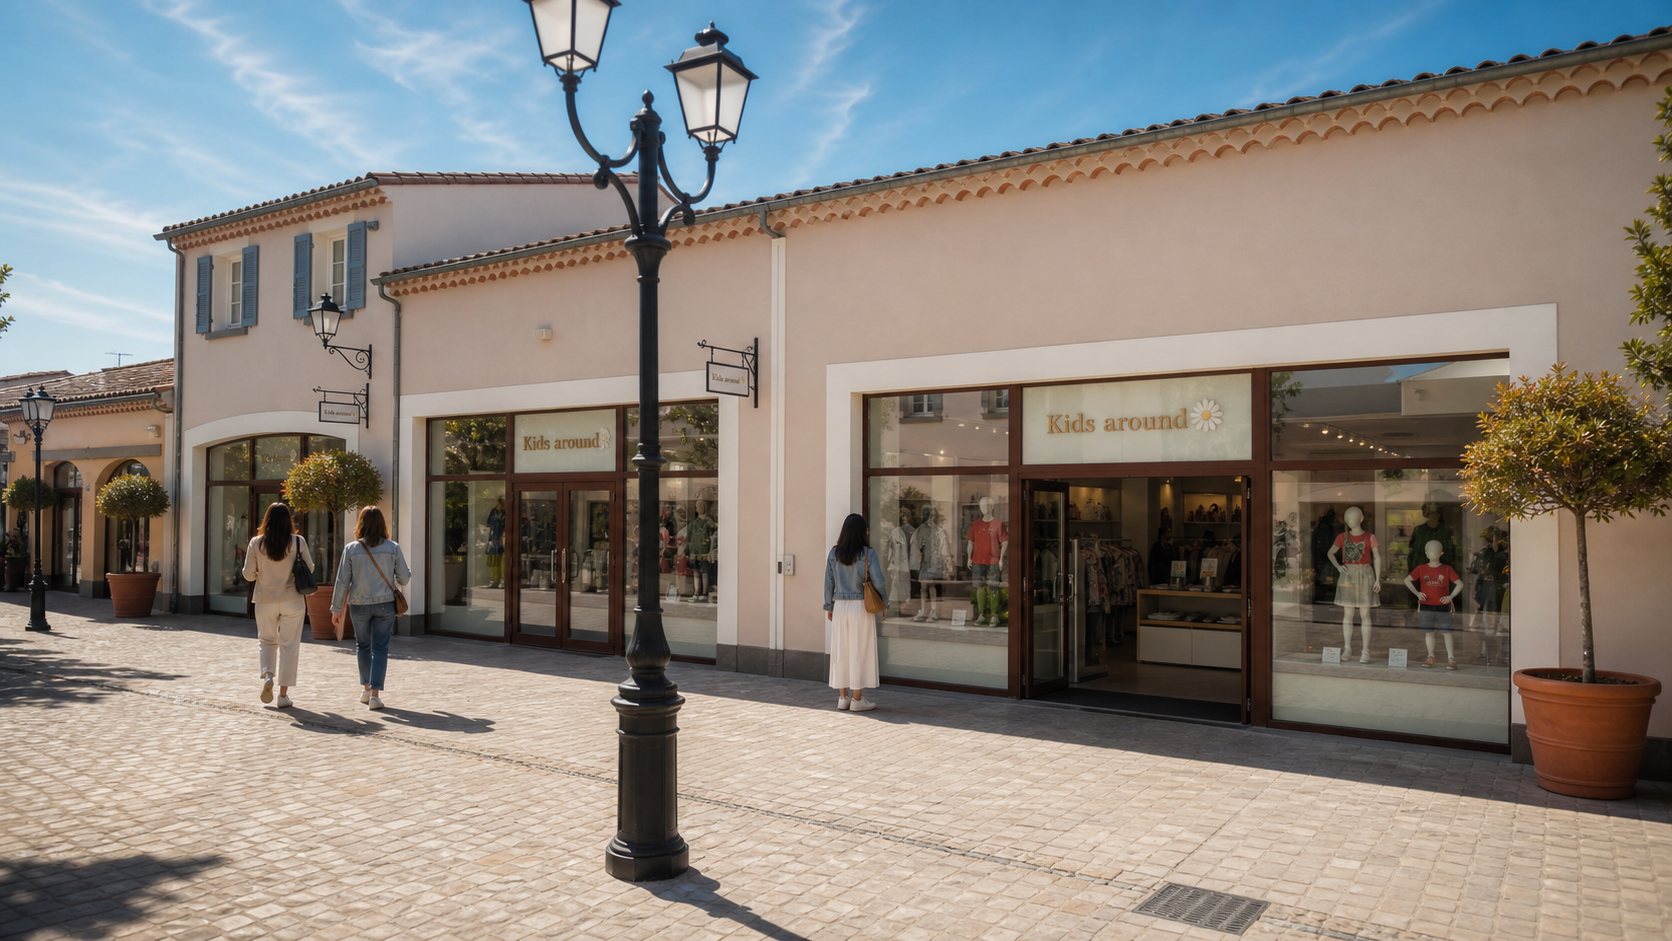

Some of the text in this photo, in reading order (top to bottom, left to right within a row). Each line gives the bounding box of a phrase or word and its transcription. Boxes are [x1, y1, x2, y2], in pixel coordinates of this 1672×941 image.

[1046, 408, 1189, 434] Kids around
[523, 432, 600, 451] Kids around
